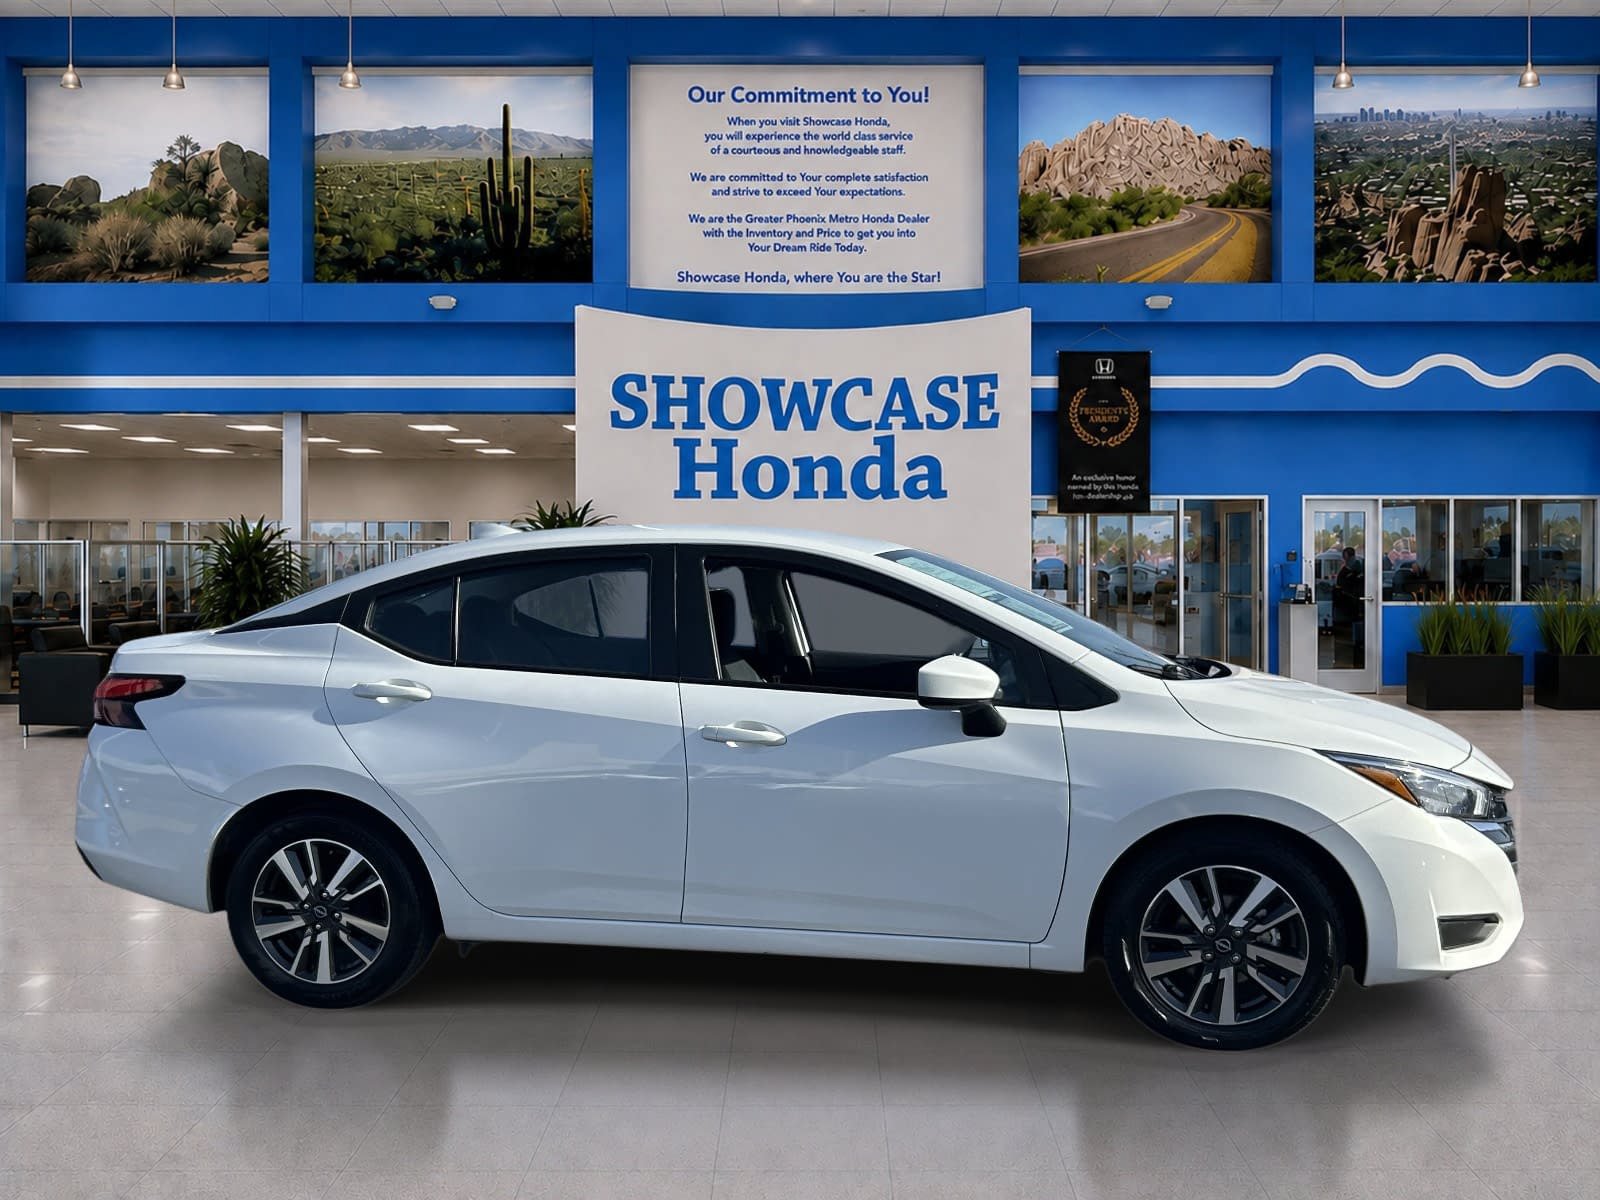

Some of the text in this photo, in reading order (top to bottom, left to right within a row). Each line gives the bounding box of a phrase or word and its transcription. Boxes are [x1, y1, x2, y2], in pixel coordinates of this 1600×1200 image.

[688, 85, 929, 104] Our Commitment to You!
[726, 116, 890, 129] When you visit Showcase Honda,
[704, 130, 913, 143] you will experience the world class service
[710, 144, 721, 155] of
[722, 147, 729, 155] a
[731, 146, 781, 155] courteous
[782, 145, 801, 155] and
[881, 144, 906, 155] staff.
[690, 172, 707, 182] We
[728, 172, 784, 182] committed
[786, 173, 797, 182] to
[799, 172, 823, 182] Your
[824, 172, 871, 185] complete
[873, 172, 929, 182] satisfaction
[711, 186, 905, 200] and strive to exceed Your expectations.
[688, 213, 930, 224] We are the Greater Phoenix Metro Honda Dealer
[702, 227, 916, 241] with the Inventory and Price to get you into
[747, 242, 867, 255] Your Dream Ride Today.
[677, 270, 941, 285] Showcase Honda, where You are the Star!
[610, 373, 1000, 431] SHOWCASE
[672, 434, 948, 500] Honda
